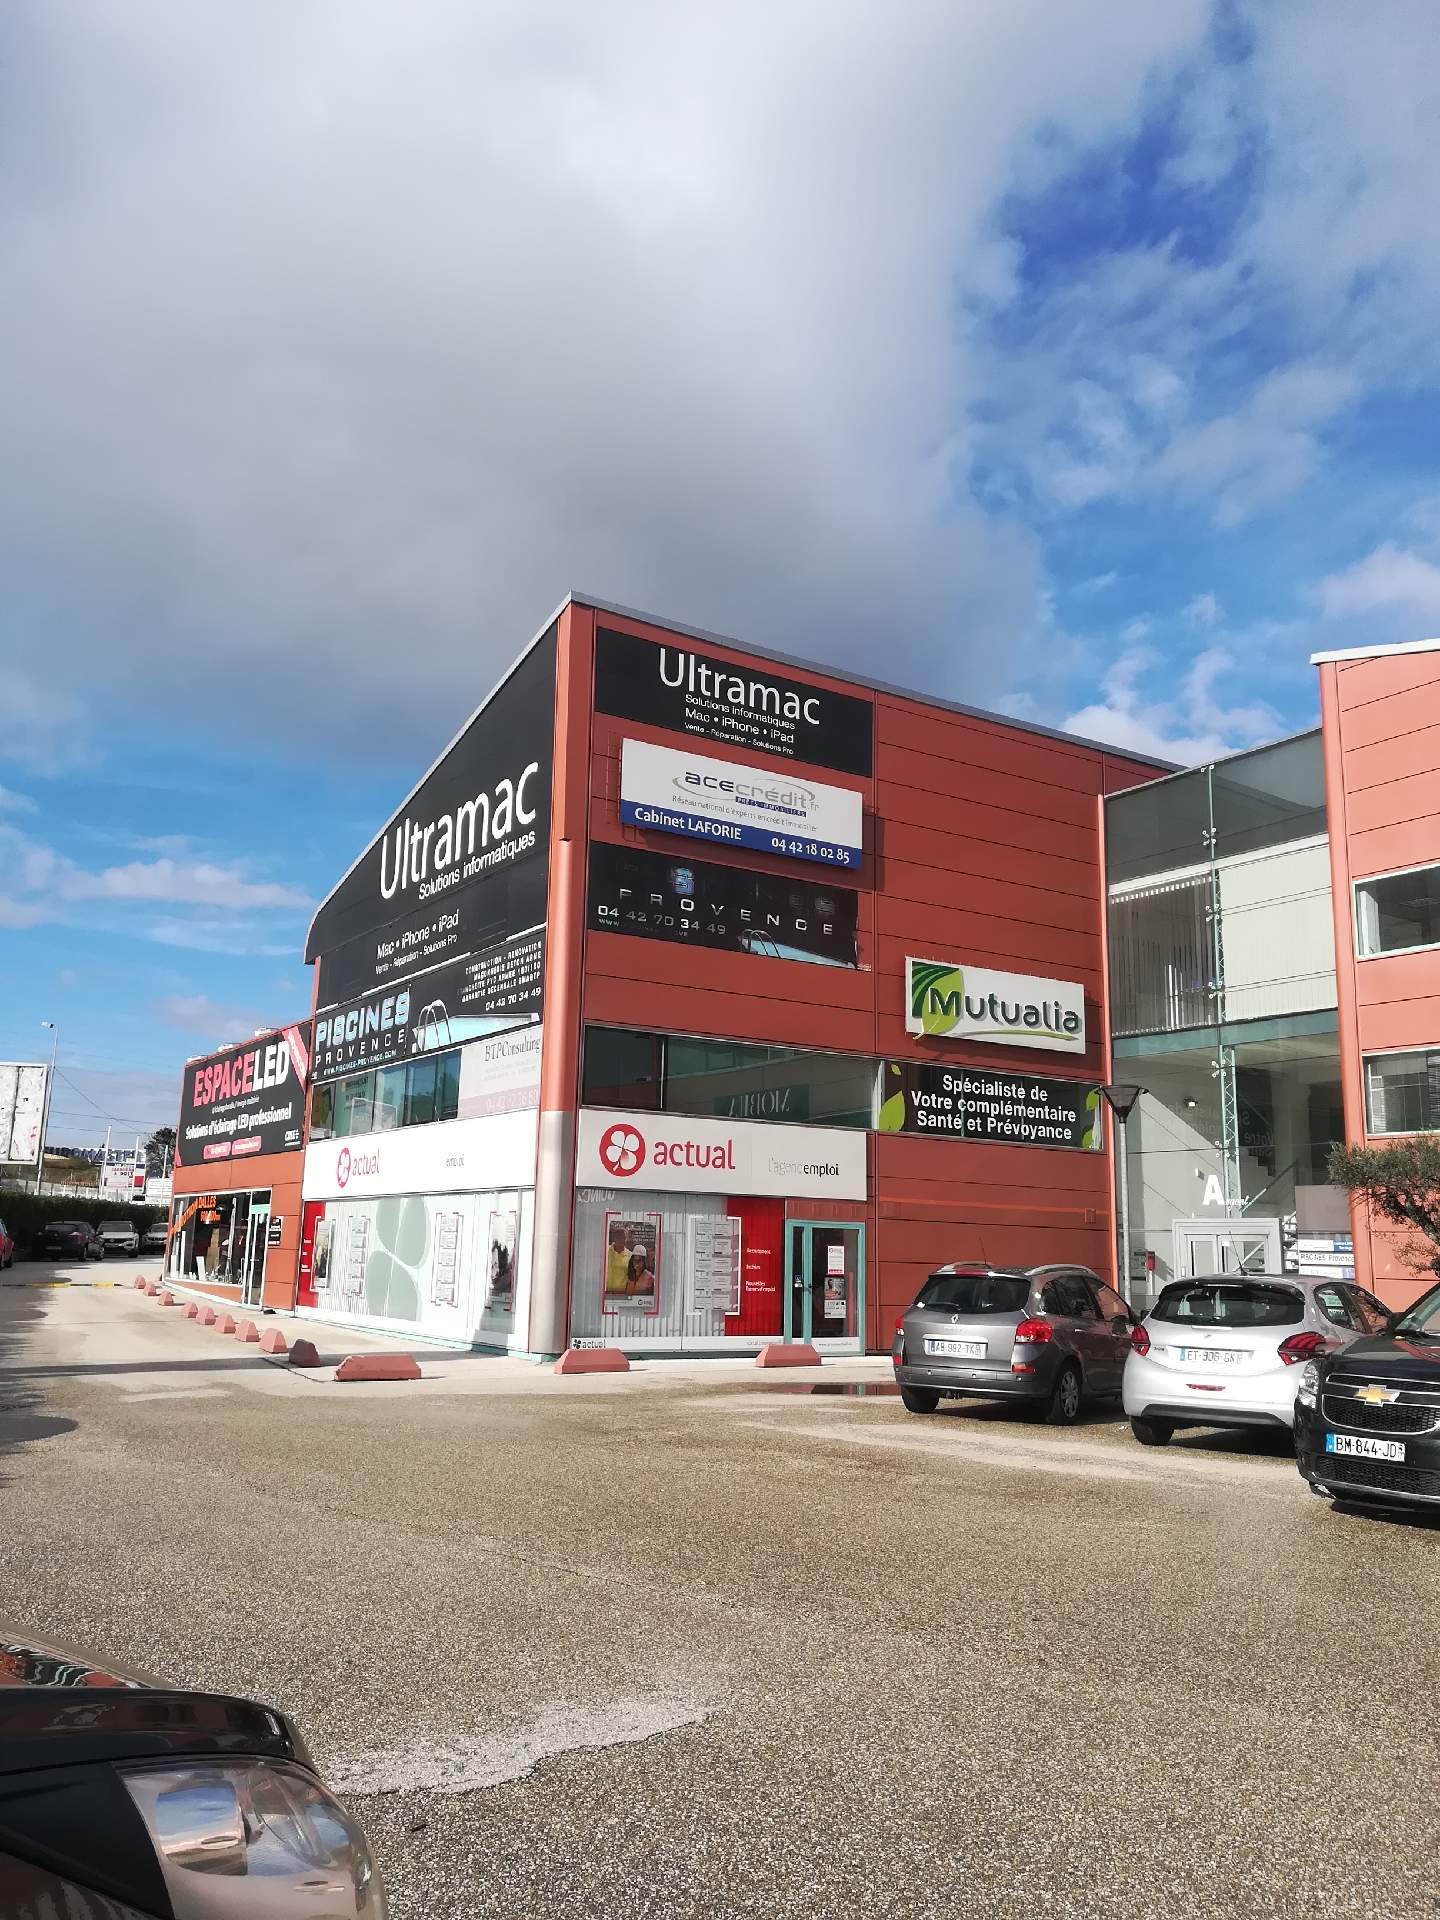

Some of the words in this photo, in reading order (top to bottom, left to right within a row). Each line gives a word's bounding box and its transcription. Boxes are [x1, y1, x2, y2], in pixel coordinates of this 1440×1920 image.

[659, 648, 820, 725] Ultramac
[685, 694, 729, 713] Solutions
[732, 706, 796, 729] informatiques
[685, 708, 710, 722] Mac
[722, 716, 760, 735] iPhone
[770, 729, 794, 743] iPad
[685, 722, 705, 733] Vente
[753, 739, 782, 752] Solutions
[698, 799, 725, 814] national
[380, 762, 539, 899] Ultramac
[634, 807, 685, 829] Cabinet
[688, 814, 742, 840] LAFORIE
[419, 867, 460, 900] Solutions
[463, 830, 536, 878] informatiques
[771, 837, 787, 853] 04
[789, 840, 803, 853] 42
[805, 843, 818, 856] 18
[821, 848, 834, 860] 02
[837, 850, 850, 864] 85
[377, 942, 395, 959] Mac
[401, 926, 430, 949] iPhone
[438, 908, 460, 932] iPad
[598, 905, 619, 918] 04
[626, 911, 647, 922] 42
[653, 914, 674, 926] 70
[680, 918, 700, 931] 34
[707, 923, 726, 935] 49
[423, 938, 447, 956] Solutions
[447, 934, 458, 945] Pro
[485, 1000, 495, 1011] 04
[507, 994, 517, 1005] 70
[518, 990, 529, 1001] 34
[531, 987, 542, 997] 49
[928, 987, 1081, 1033] Mutualia
[315, 990, 410, 1051] PISCINES
[315, 1029, 405, 1068] PROVENCE
[942, 1074, 1026, 1099] Spécialiste
[1030, 1085, 1048, 1102] de
[238, 1113, 250, 1130] LED
[249, 1102, 292, 1131] professionnel
[911, 1090, 952, 1110] Votre
[957, 1095, 1076, 1123] complémentaire
[917, 1110, 962, 1130] Santé
[966, 1116, 982, 1132] et
[987, 1117, 1072, 1140] Prévoyance
[352, 1147, 380, 1176] actual
[653, 1139, 736, 1170] actual
[803, 1163, 840, 1178] emploi
[582, 1339, 606, 1349] actual
[1336, 1437, 1397, 1458] BM-844-JD
